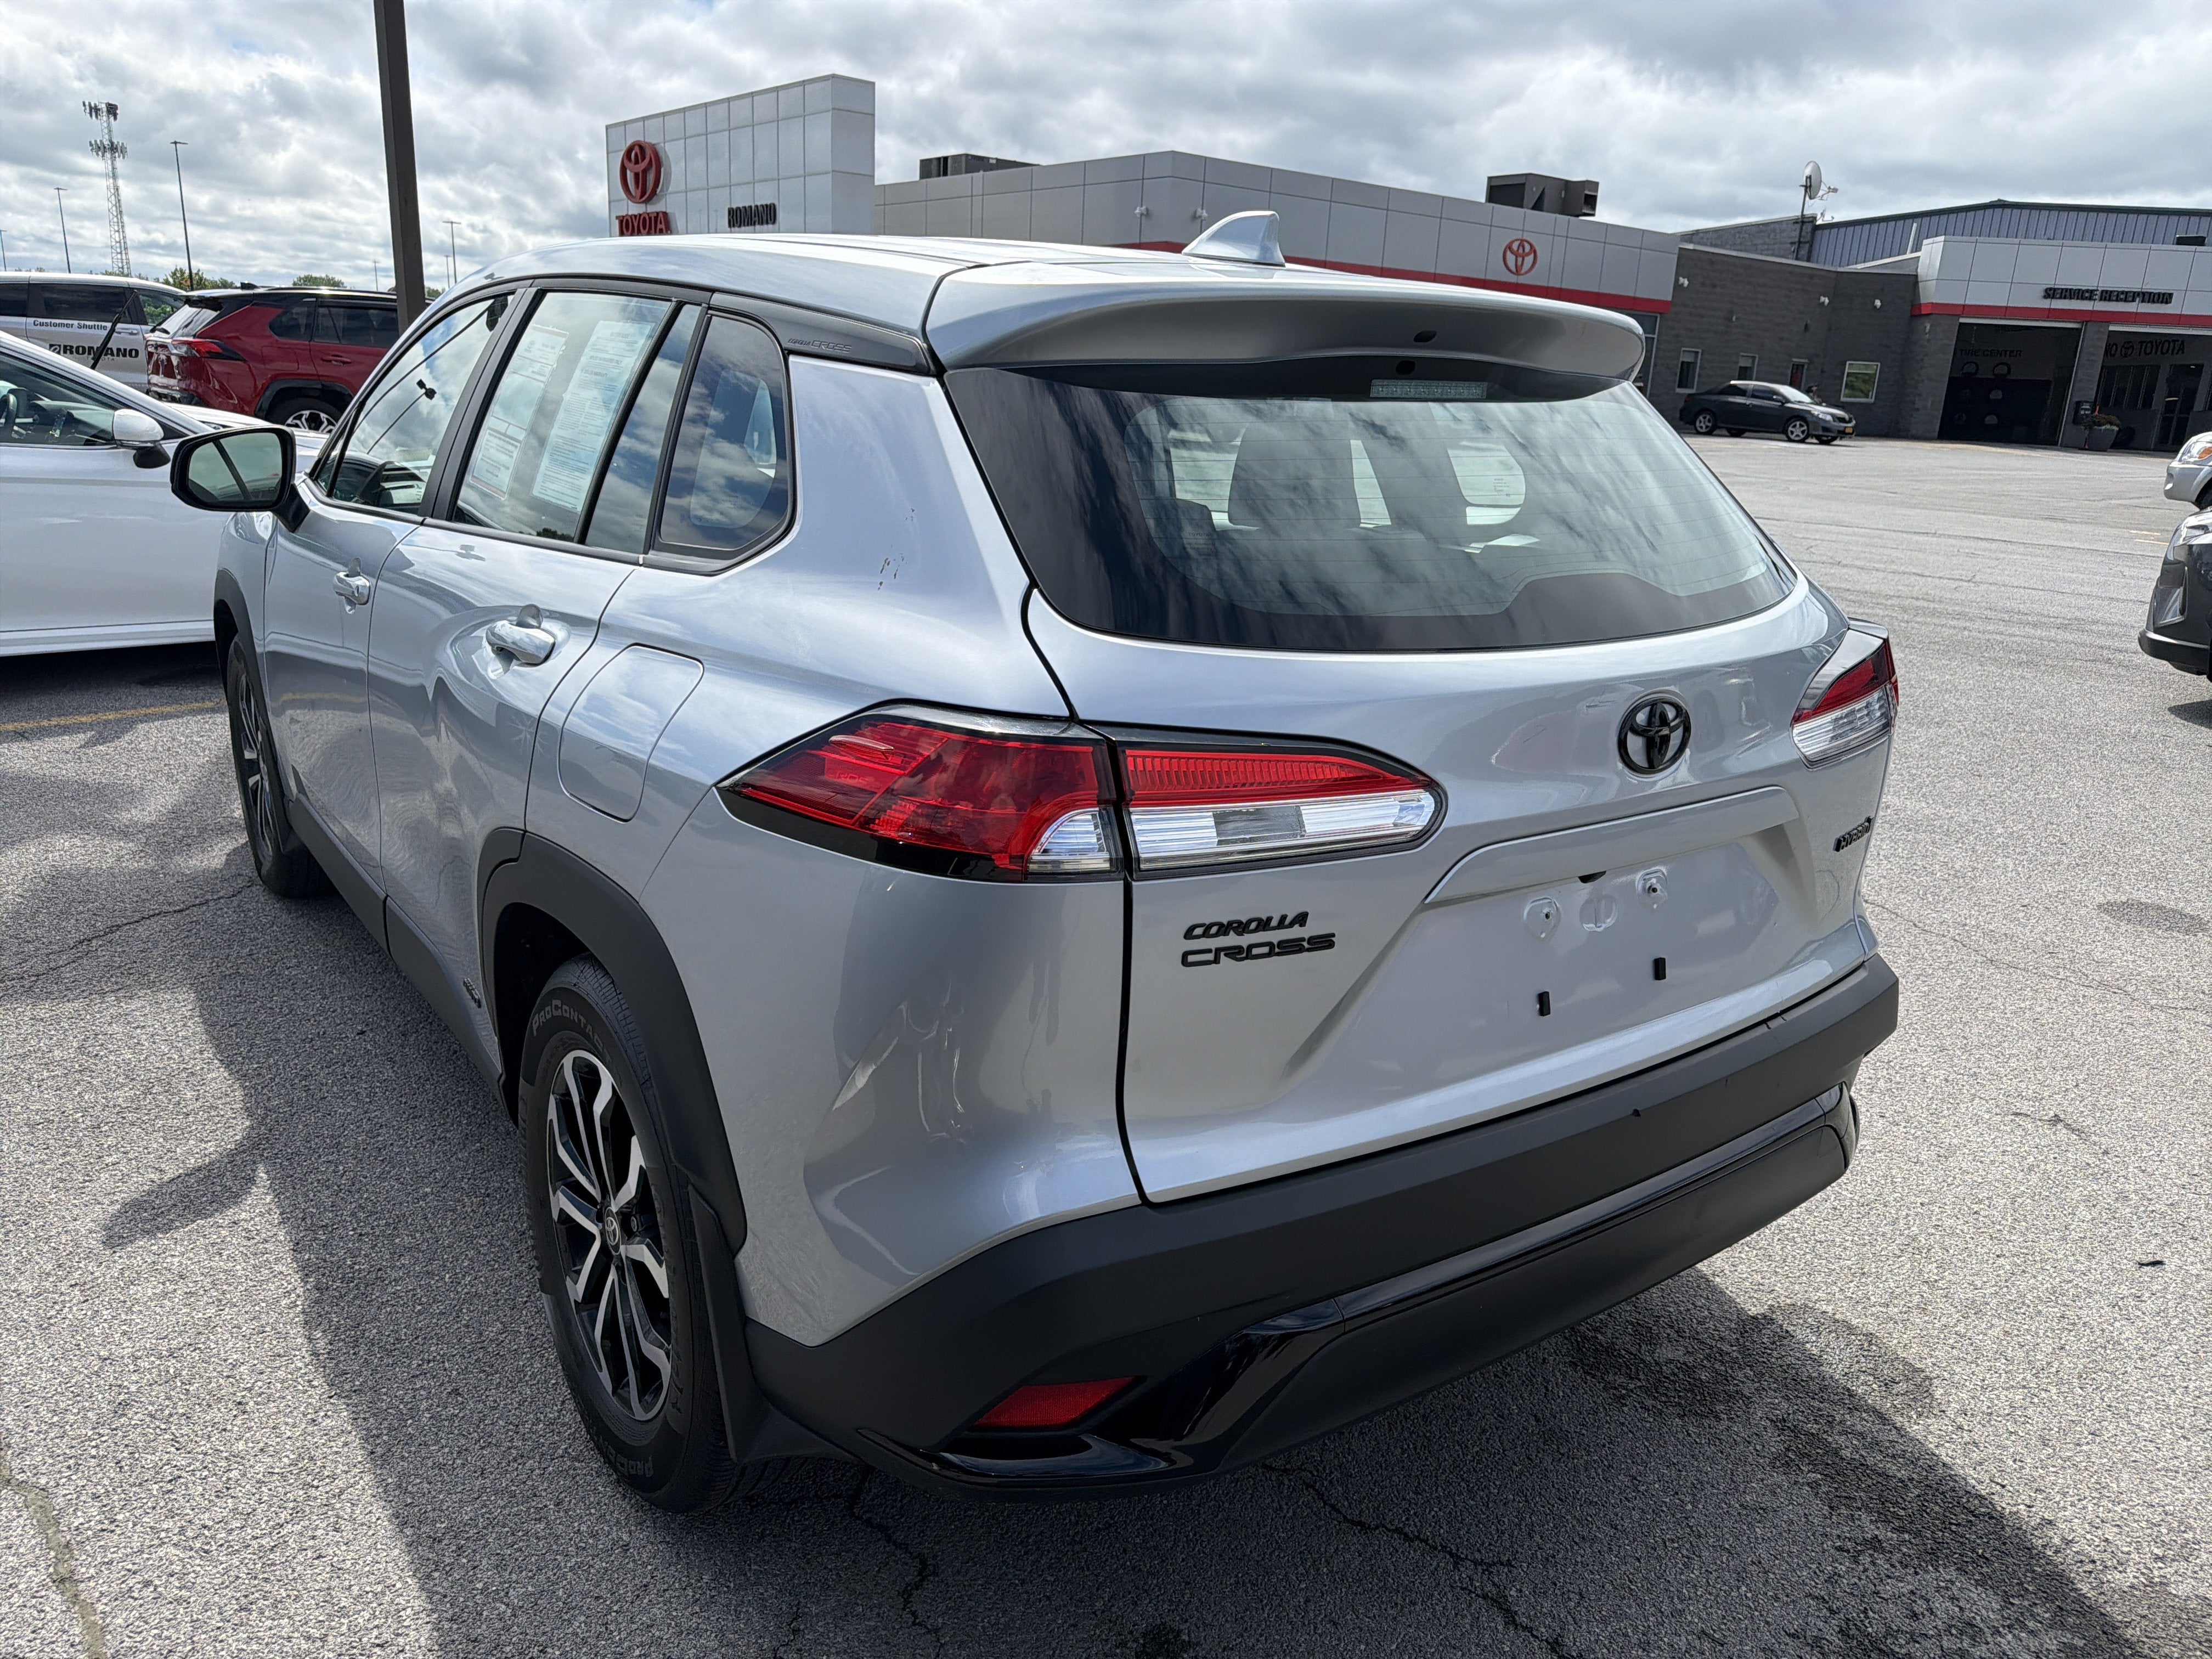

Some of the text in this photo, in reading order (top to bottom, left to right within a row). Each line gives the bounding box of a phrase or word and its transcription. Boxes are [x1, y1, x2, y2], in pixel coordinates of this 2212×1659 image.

[616, 211, 670, 236] TOYOTA
[728, 203, 776, 228] ROMANO
[2043, 287, 2174, 304] SERVICE RECEPTION
[33, 319, 108, 331] Customer Shuttle
[811, 340, 852, 353] CROSS
[1983, 349, 2022, 358] CENTER
[2139, 338, 2185, 356] TOYOTA
[1835, 817, 1871, 852] HYBRID
[1183, 911, 1309, 940] COROLLA
[1181, 933, 1336, 967] CROSS
